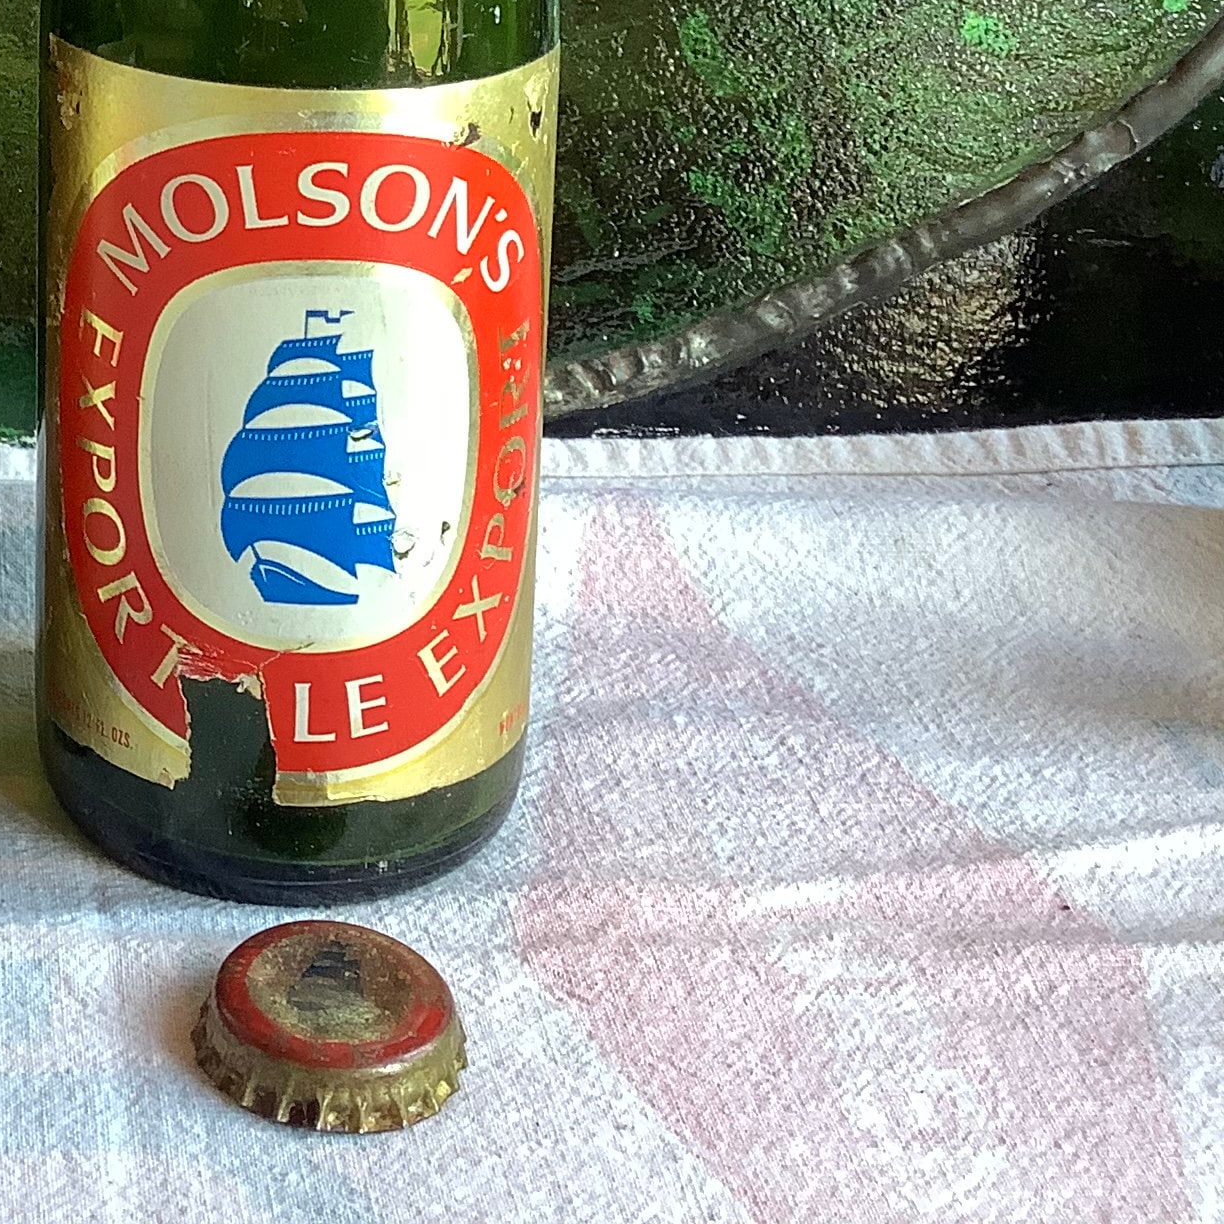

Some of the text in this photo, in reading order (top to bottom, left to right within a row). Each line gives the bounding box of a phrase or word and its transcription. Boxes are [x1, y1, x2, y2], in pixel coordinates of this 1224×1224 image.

[95, 161, 525, 297] MOLSON'S
[77, 307, 200, 689] EXPORT
[293, 318, 530, 742] LE EXPORT
